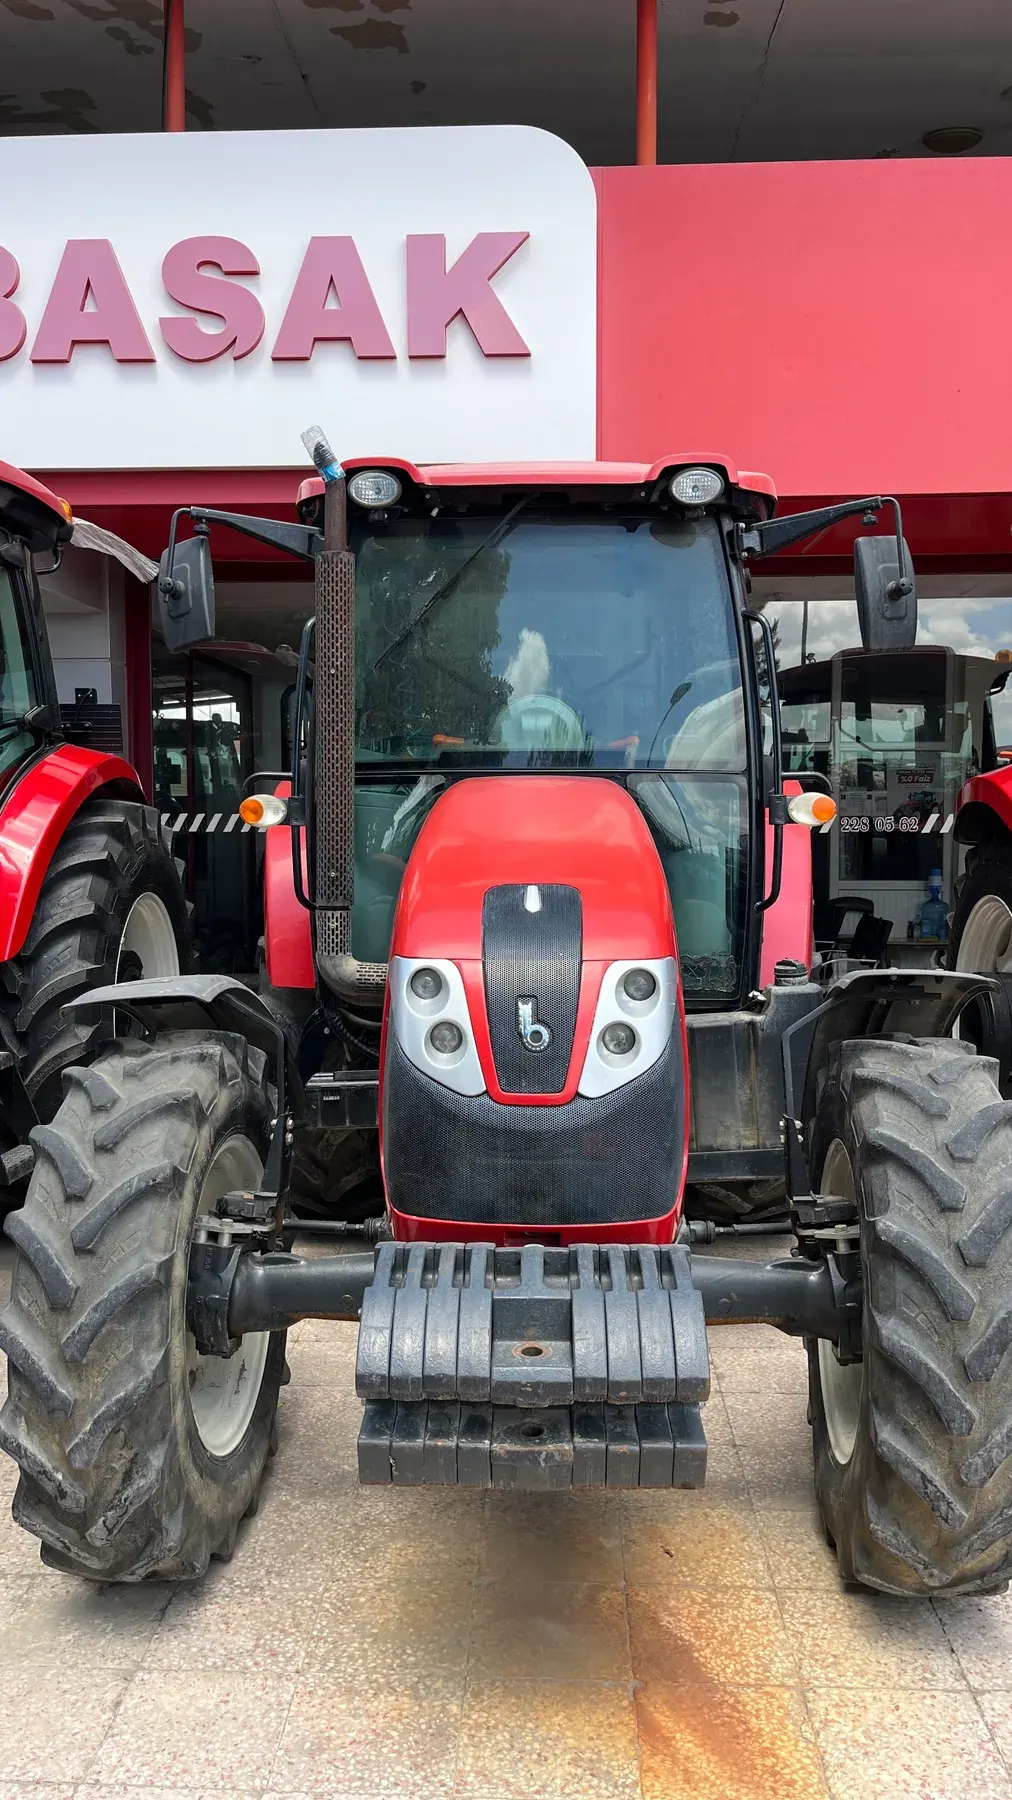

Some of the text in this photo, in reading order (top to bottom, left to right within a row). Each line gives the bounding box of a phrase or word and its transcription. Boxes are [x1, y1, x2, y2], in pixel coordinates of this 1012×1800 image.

[0, 232, 531, 363] ASAK
[841, 816, 918, 832] 228 05 62
